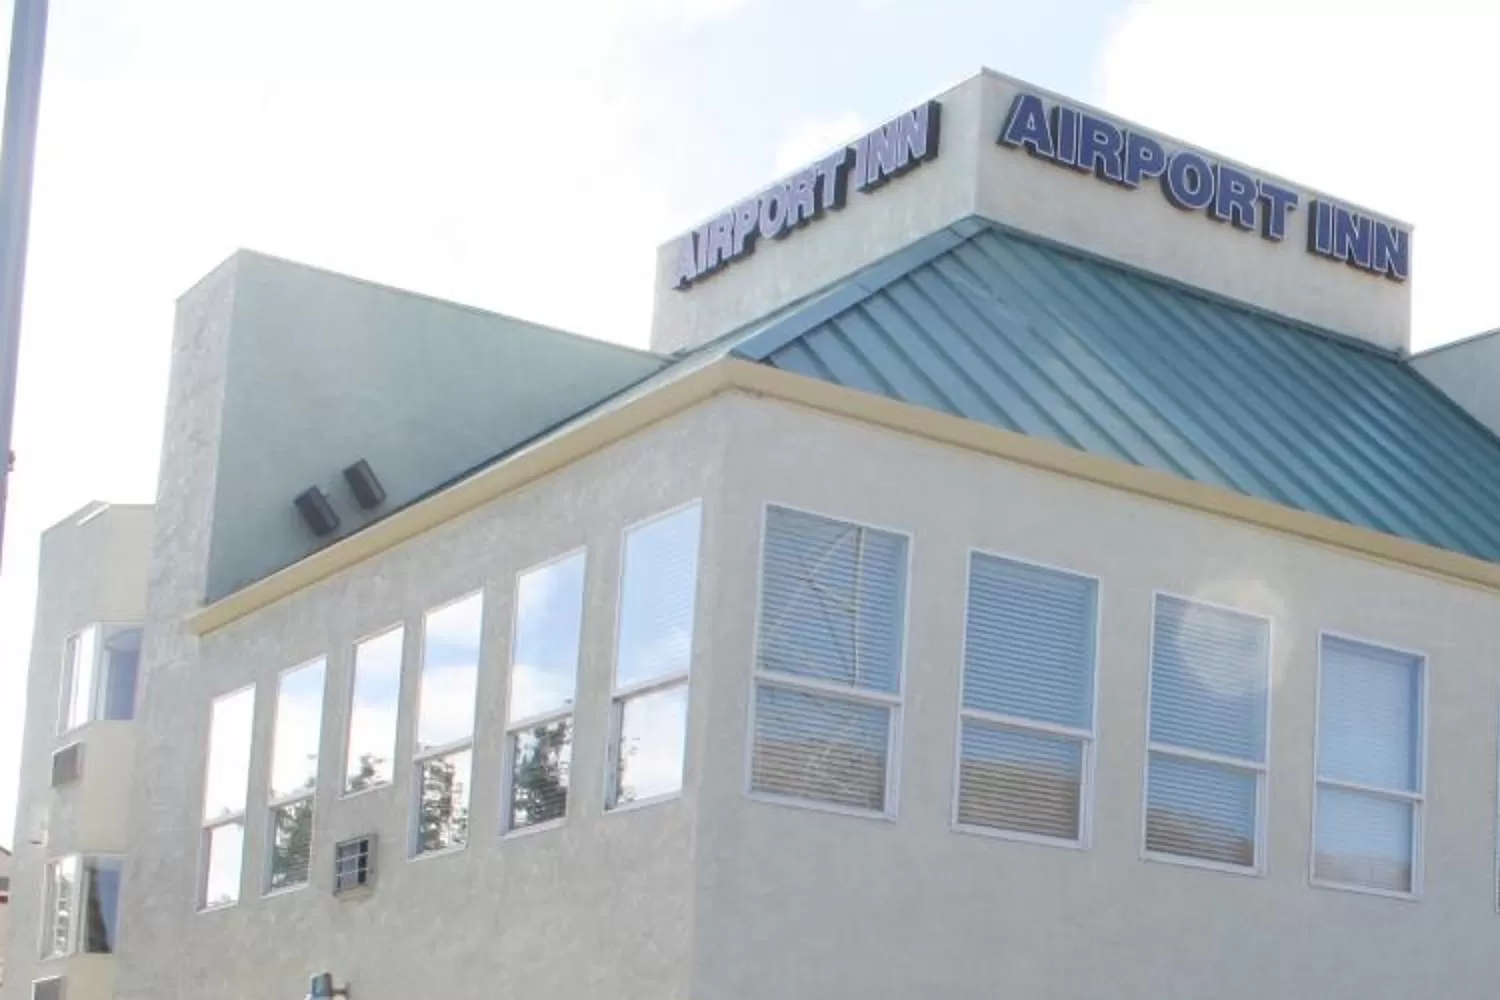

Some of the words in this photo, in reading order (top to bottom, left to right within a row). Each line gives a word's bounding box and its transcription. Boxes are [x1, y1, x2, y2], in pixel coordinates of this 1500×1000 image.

[673, 145, 854, 290] AIRPORT
[855, 99, 941, 194] INN
[999, 94, 1299, 242] AIRPORT
[1308, 198, 1409, 282] INN
